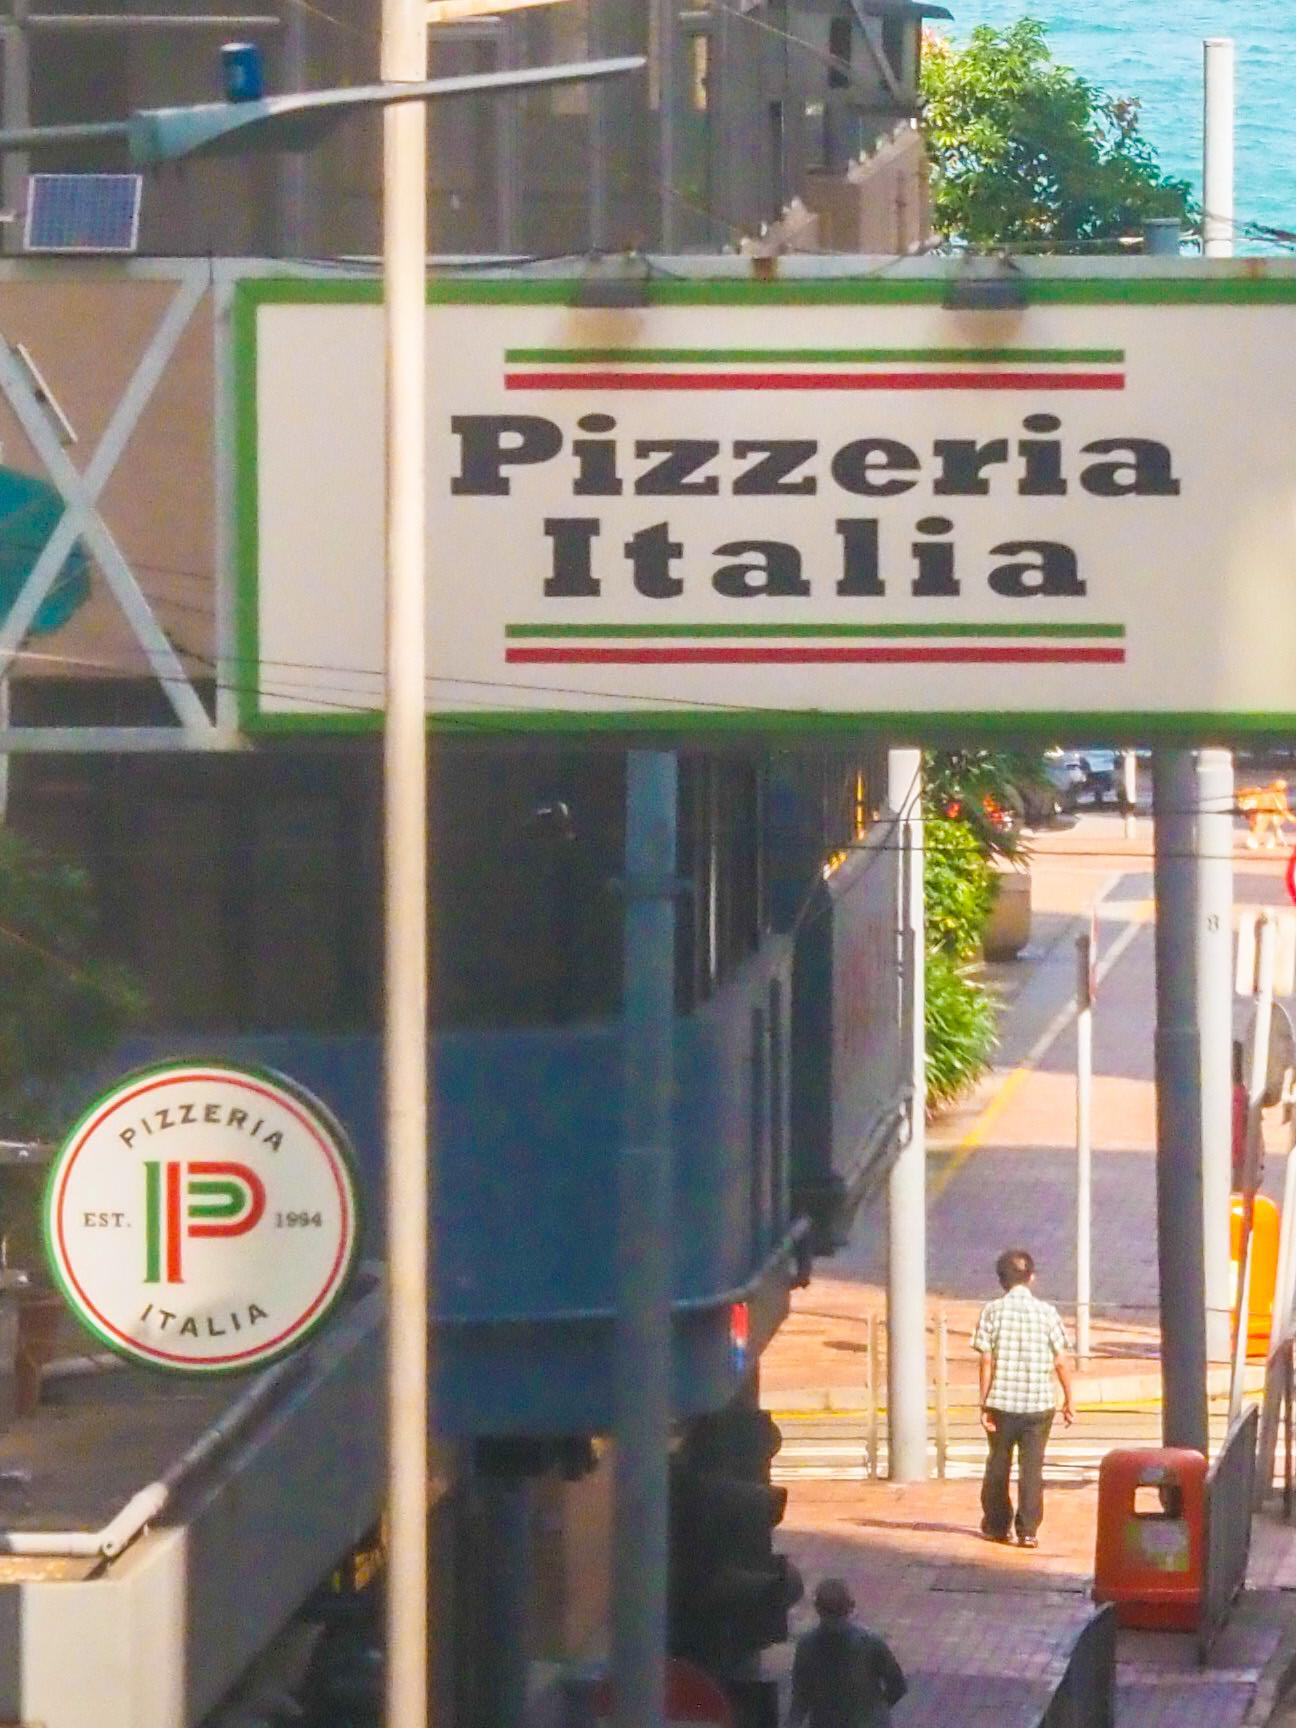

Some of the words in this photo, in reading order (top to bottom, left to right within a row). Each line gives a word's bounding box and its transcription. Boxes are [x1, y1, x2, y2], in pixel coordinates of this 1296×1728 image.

[451, 413, 1180, 496] Pizzeria
[543, 517, 1087, 598] Italia
[119, 1104, 283, 1151] PIZZERIA
[84, 1212, 132, 1228] EST.
[141, 1303, 268, 1337] ITALIA
